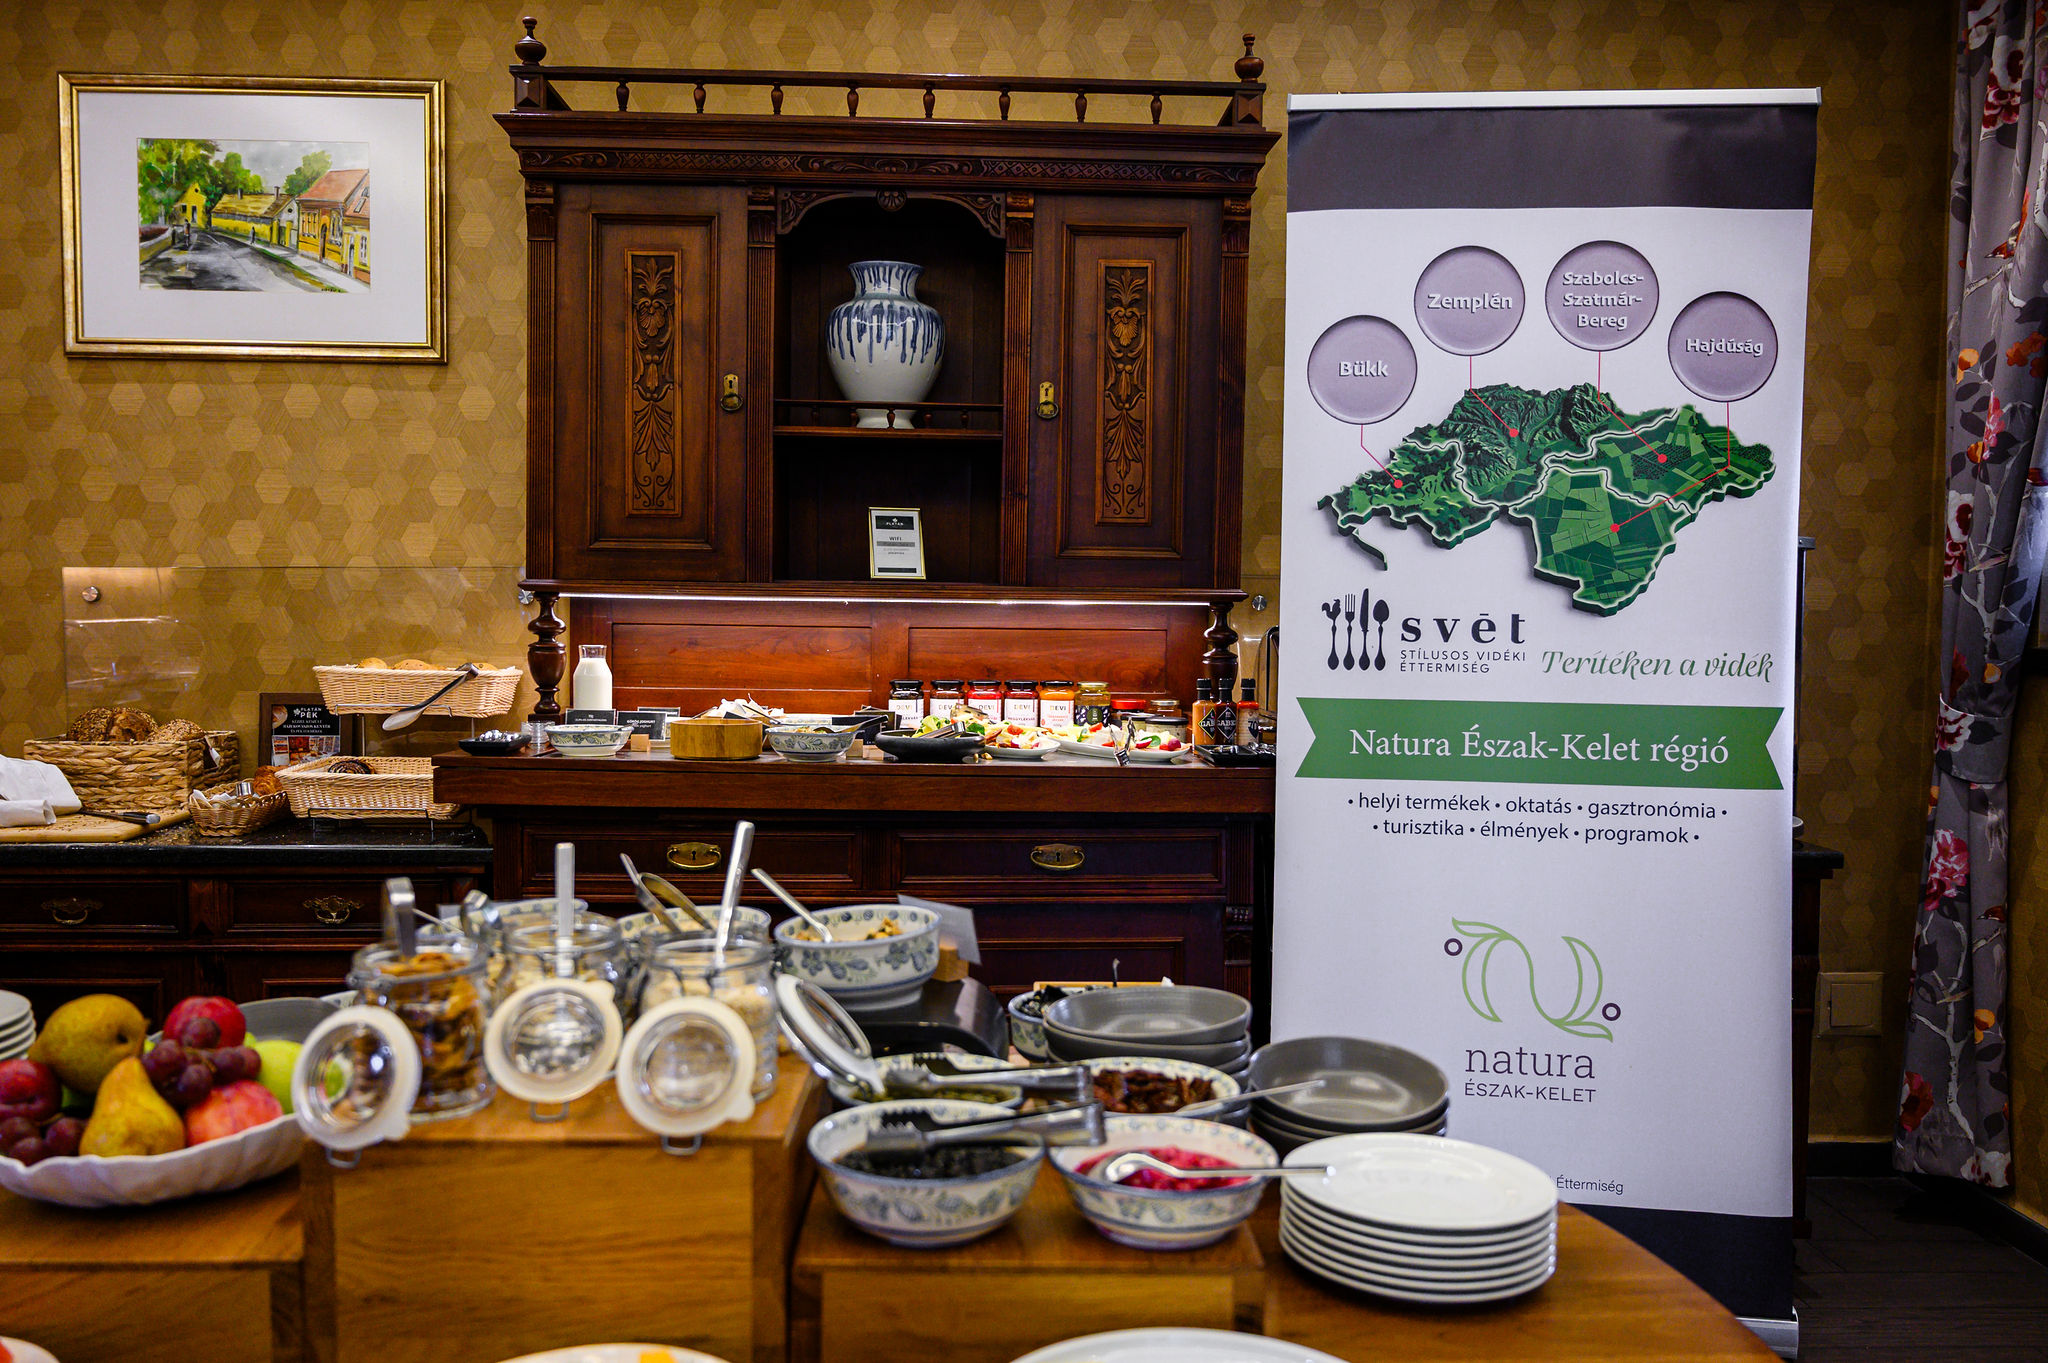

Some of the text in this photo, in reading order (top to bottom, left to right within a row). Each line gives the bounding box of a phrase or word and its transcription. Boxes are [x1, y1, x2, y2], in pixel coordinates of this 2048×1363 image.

[1563, 271, 1644, 286] Szabolcs-
[1427, 292, 1513, 313] Zemplén
[1563, 292, 1643, 307] Szatmár-
[1577, 314, 1628, 331] Bereg
[1339, 360, 1388, 377] Bükk
[1400, 647, 1526, 663] STÍLUSOS VIDÉKI
[1400, 661, 1490, 674] ÉTTERMISÉG
[1543, 651, 1773, 682] Terítéken a vidék
[300, 710, 318, 719] PÉK
[1350, 724, 1728, 771] Natura Észak-Kelet régió
[1359, 792, 1716, 820] helyi termékek oktatás gasztronómia
[1383, 819, 1688, 845] turisztika élmények programok
[1465, 1046, 1595, 1079] natura
[1464, 1079, 1597, 1103] ÉSZAK-KELET
[1557, 1175, 1623, 1195] Éttermiség
